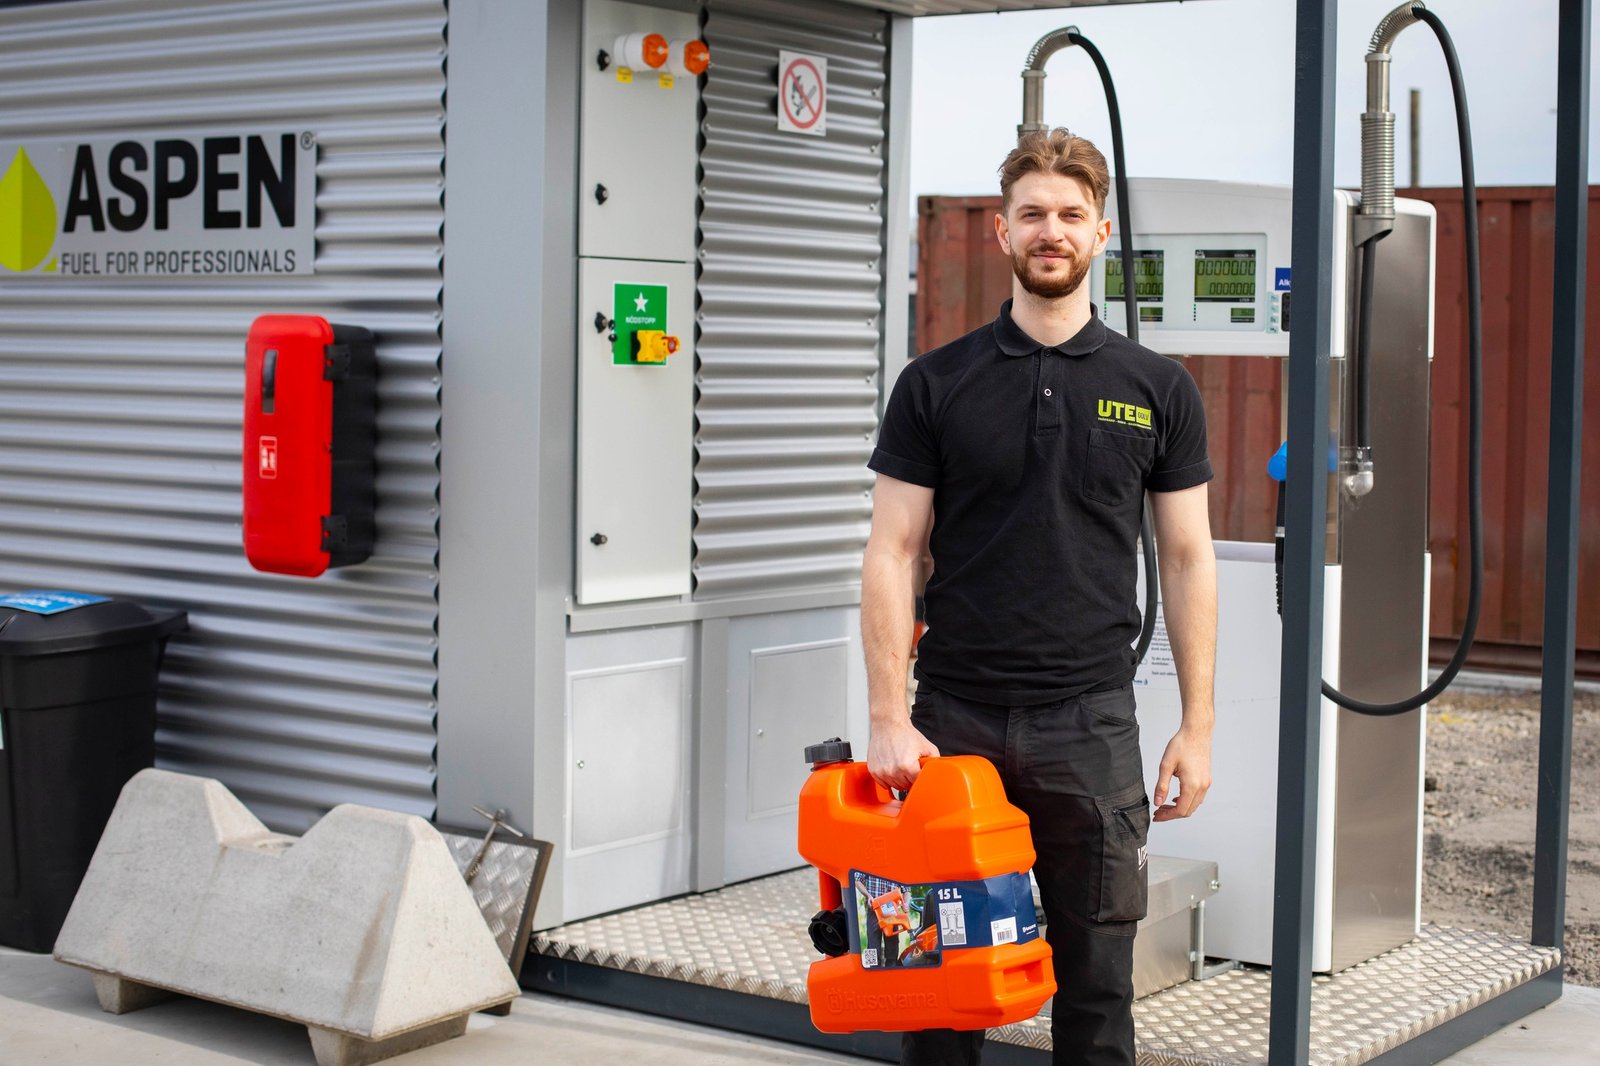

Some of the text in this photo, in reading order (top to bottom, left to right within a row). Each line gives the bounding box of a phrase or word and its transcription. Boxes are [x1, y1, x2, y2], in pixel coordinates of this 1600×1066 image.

[63, 133, 296, 233] ASPEN
[61, 249, 296, 275] FUEL FOR PROFESSIONALS
[1098, 399, 1136, 422] UTE
[937, 887, 962, 900] 15 L
[844, 991, 938, 1012] Husqvarna
